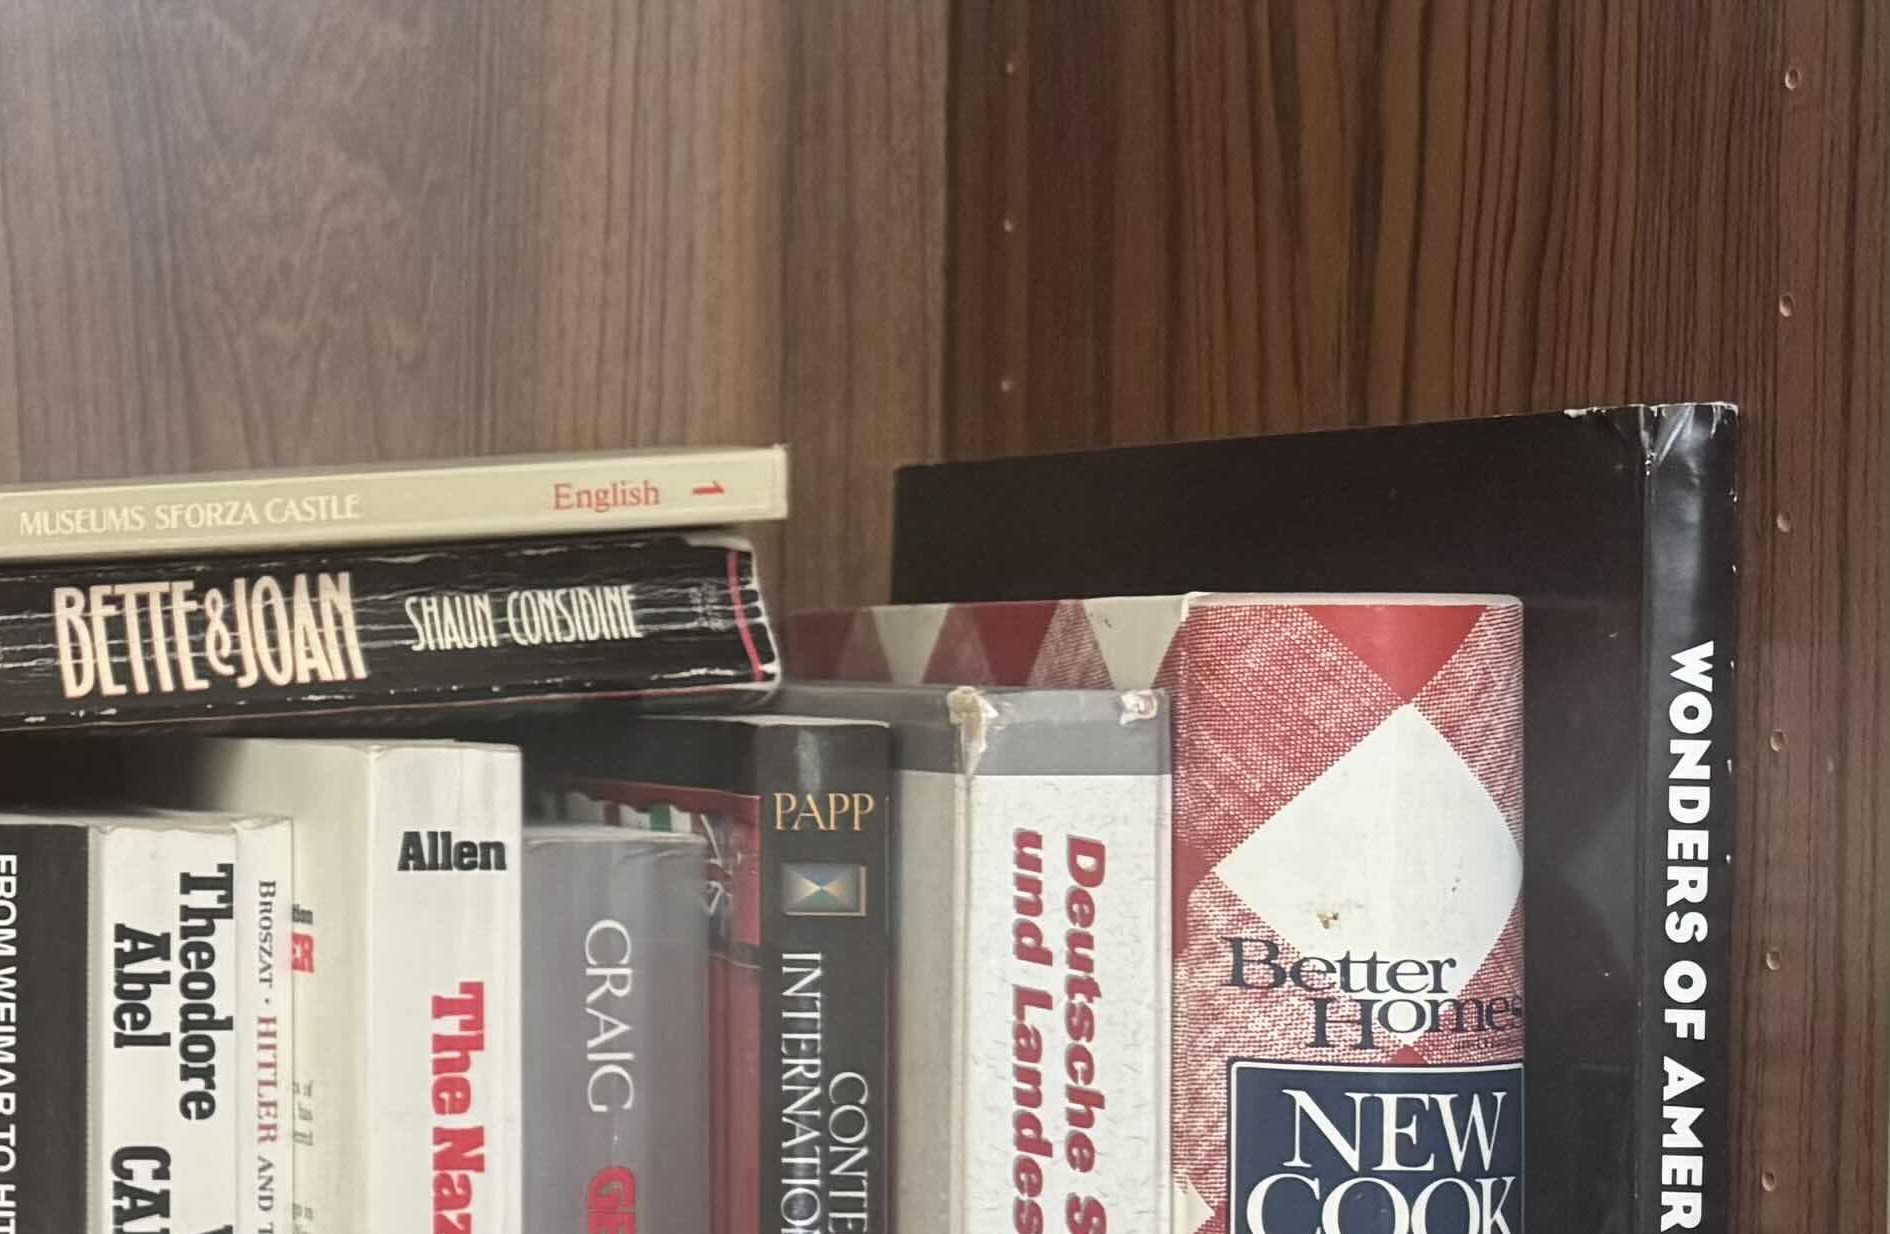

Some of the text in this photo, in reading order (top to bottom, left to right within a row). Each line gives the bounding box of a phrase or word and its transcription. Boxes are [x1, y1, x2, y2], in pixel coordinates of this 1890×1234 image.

[20, 506, 145, 536] MUSEUMS
[155, 500, 258, 529] SFORZA
[266, 494, 360, 522] CASTLE
[554, 481, 659, 512] English
[773, 792, 875, 832] PAPP
[1663, 641, 1714, 943] WONDERS
[397, 831, 508, 872] Allen
[1013, 828, 1053, 962] und
[1065, 833, 1107, 1173] Deutsche
[1226, 936, 1456, 995] Better
[1662, 959, 1707, 1041] OF
[585, 919, 634, 1113] CRAIG
[1283, 1090, 1505, 1172] NEW
